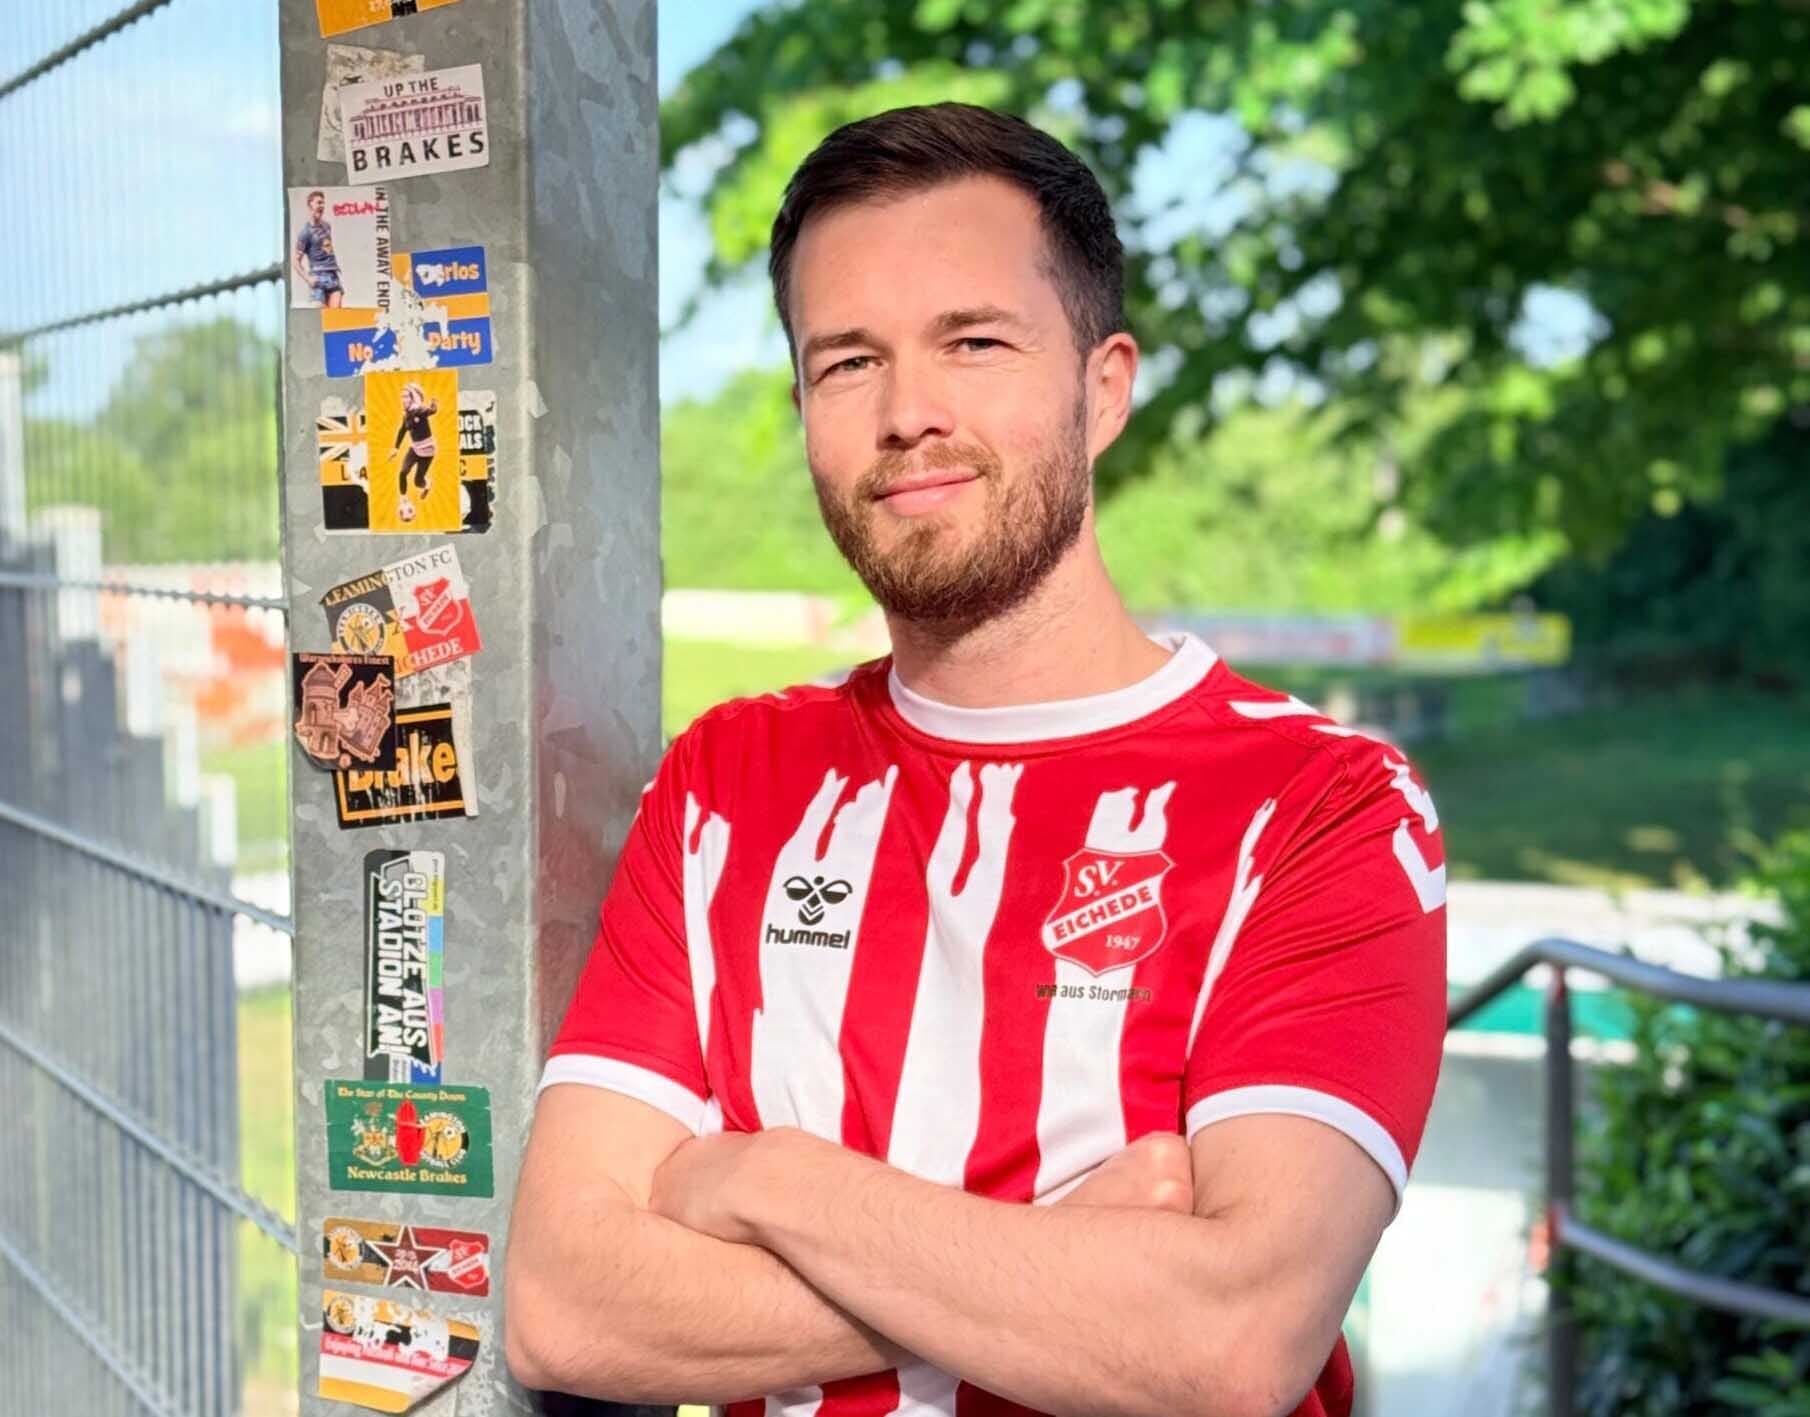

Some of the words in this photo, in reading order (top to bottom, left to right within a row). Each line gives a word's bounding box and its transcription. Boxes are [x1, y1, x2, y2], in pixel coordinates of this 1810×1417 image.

[383, 82, 404, 98] UP
[408, 77, 439, 93] THE
[352, 131, 485, 172] BRAKES
[376, 206, 389, 232] THE
[376, 237, 391, 278] AWAY
[347, 343, 374, 362] No
[428, 332, 482, 355] Party
[325, 558, 428, 607] LEAMINGTON
[429, 550, 453, 569] FC
[1073, 860, 1125, 898] S.V.
[402, 872, 428, 980] GLOTZE
[1051, 885, 1153, 942] EICHEDE
[378, 879, 403, 997] STADION
[765, 923, 851, 950] hummel
[1104, 934, 1142, 950] 1947
[1060, 984, 1085, 999] aus
[1089, 985, 1152, 1001] Stormarn
[402, 987, 428, 1049] AUS
[347, 1166, 417, 1182] Newcastle
[419, 1169, 467, 1184] Brakes
